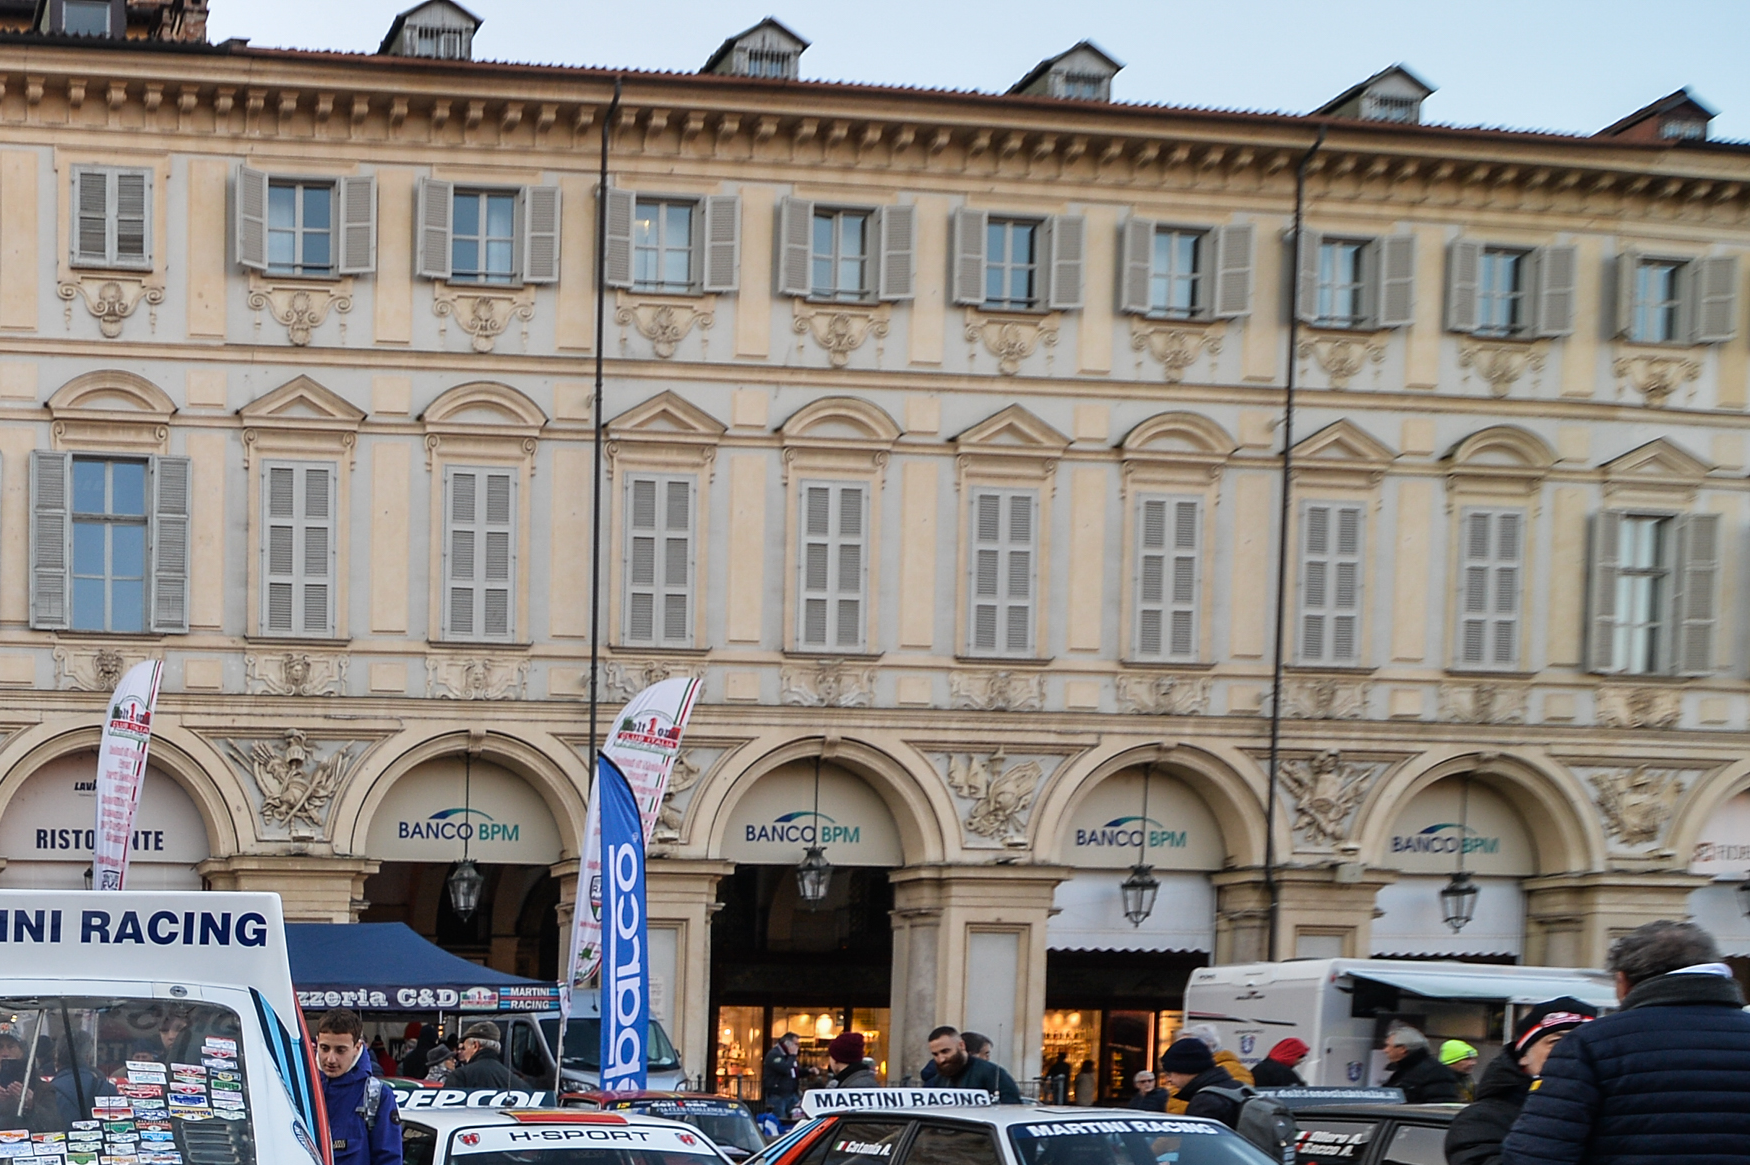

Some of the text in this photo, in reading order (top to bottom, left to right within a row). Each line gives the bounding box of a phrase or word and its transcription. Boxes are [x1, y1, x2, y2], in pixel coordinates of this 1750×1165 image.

[399, 822, 519, 841] BANCO BPM
[746, 825, 860, 843] BANCO BPM
[1076, 829, 1187, 848] BANCO BPM
[1391, 836, 1500, 854] BANCO BPM
[80, 910, 270, 948] RACING
[397, 988, 459, 1008] C&D
[510, 988, 550, 997] MARTINI
[510, 1001, 550, 1010] RACING
[815, 1092, 987, 1108] MARTINI RACING
[509, 1130, 649, 1142] H-SPORT
[1026, 1121, 1218, 1137] MARTINI RACING
